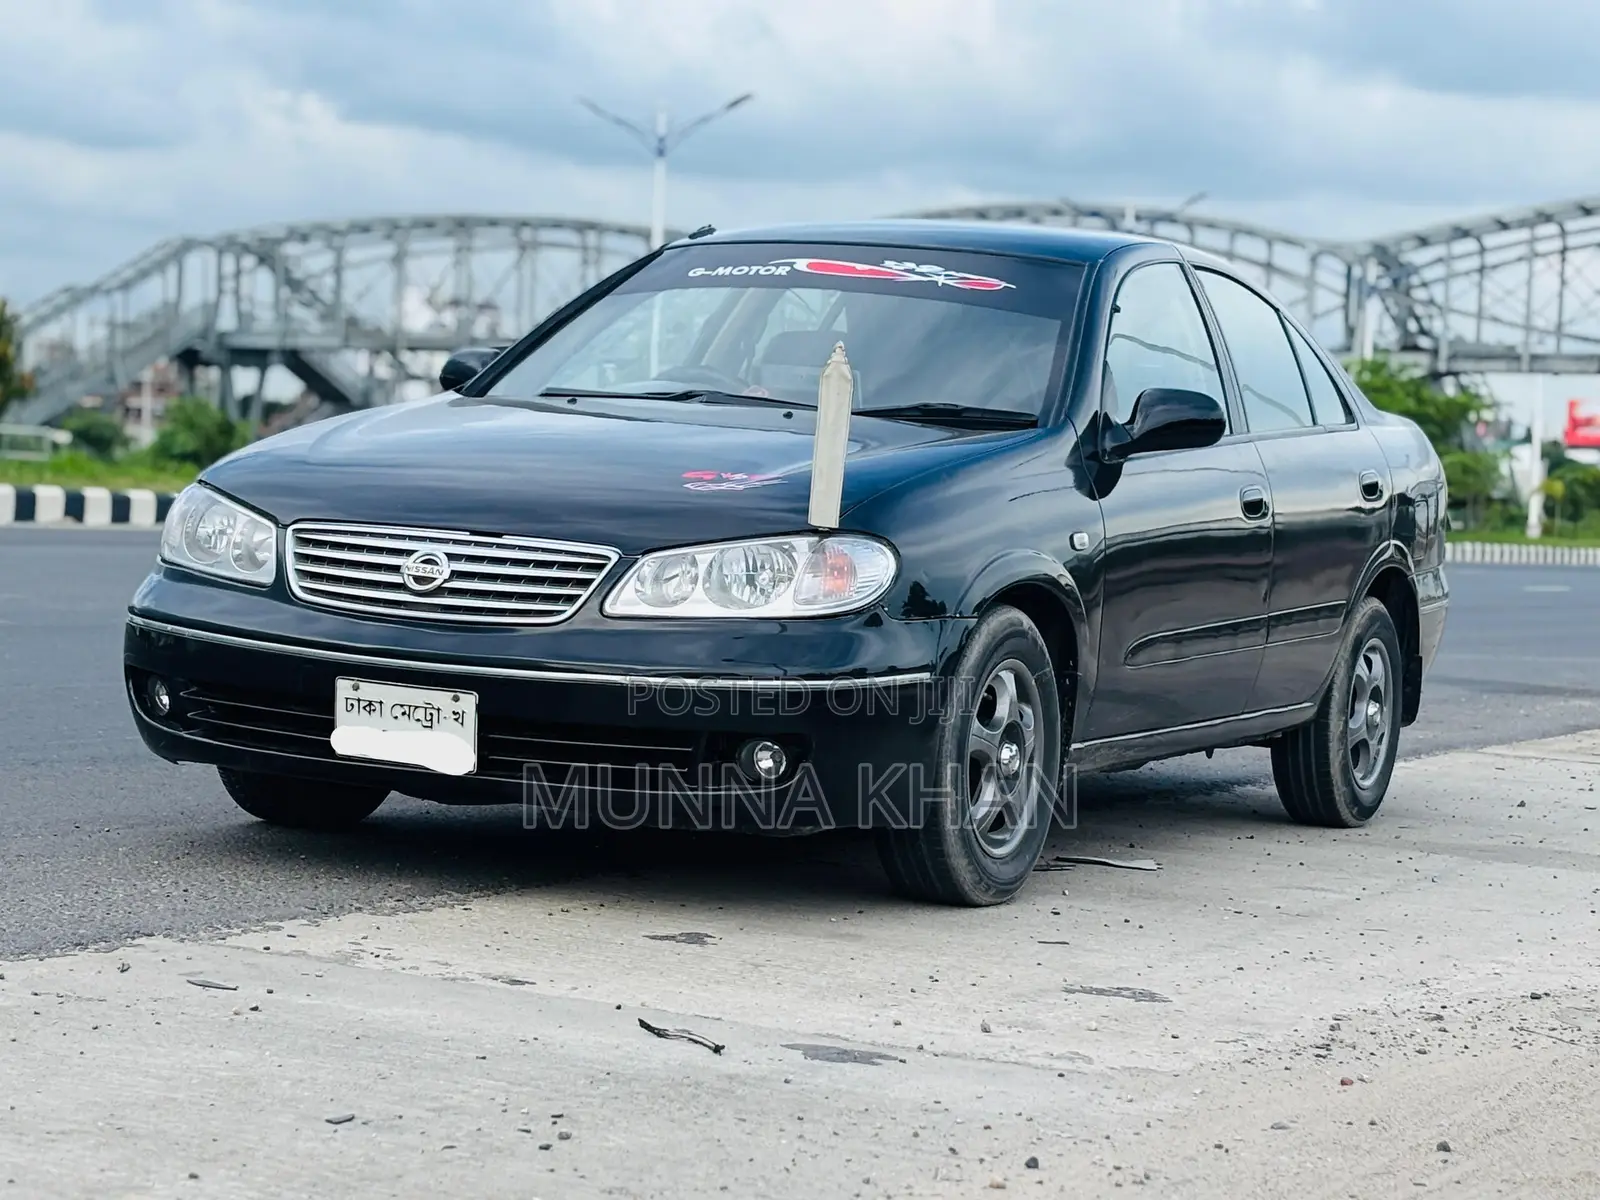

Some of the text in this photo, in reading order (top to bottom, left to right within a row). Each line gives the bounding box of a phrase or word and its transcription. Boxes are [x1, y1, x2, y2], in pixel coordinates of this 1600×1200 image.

[688, 265, 792, 277] G-MOTOR
[405, 564, 445, 576] NISSAN
[344, 697, 384, 717] ঢাকা
